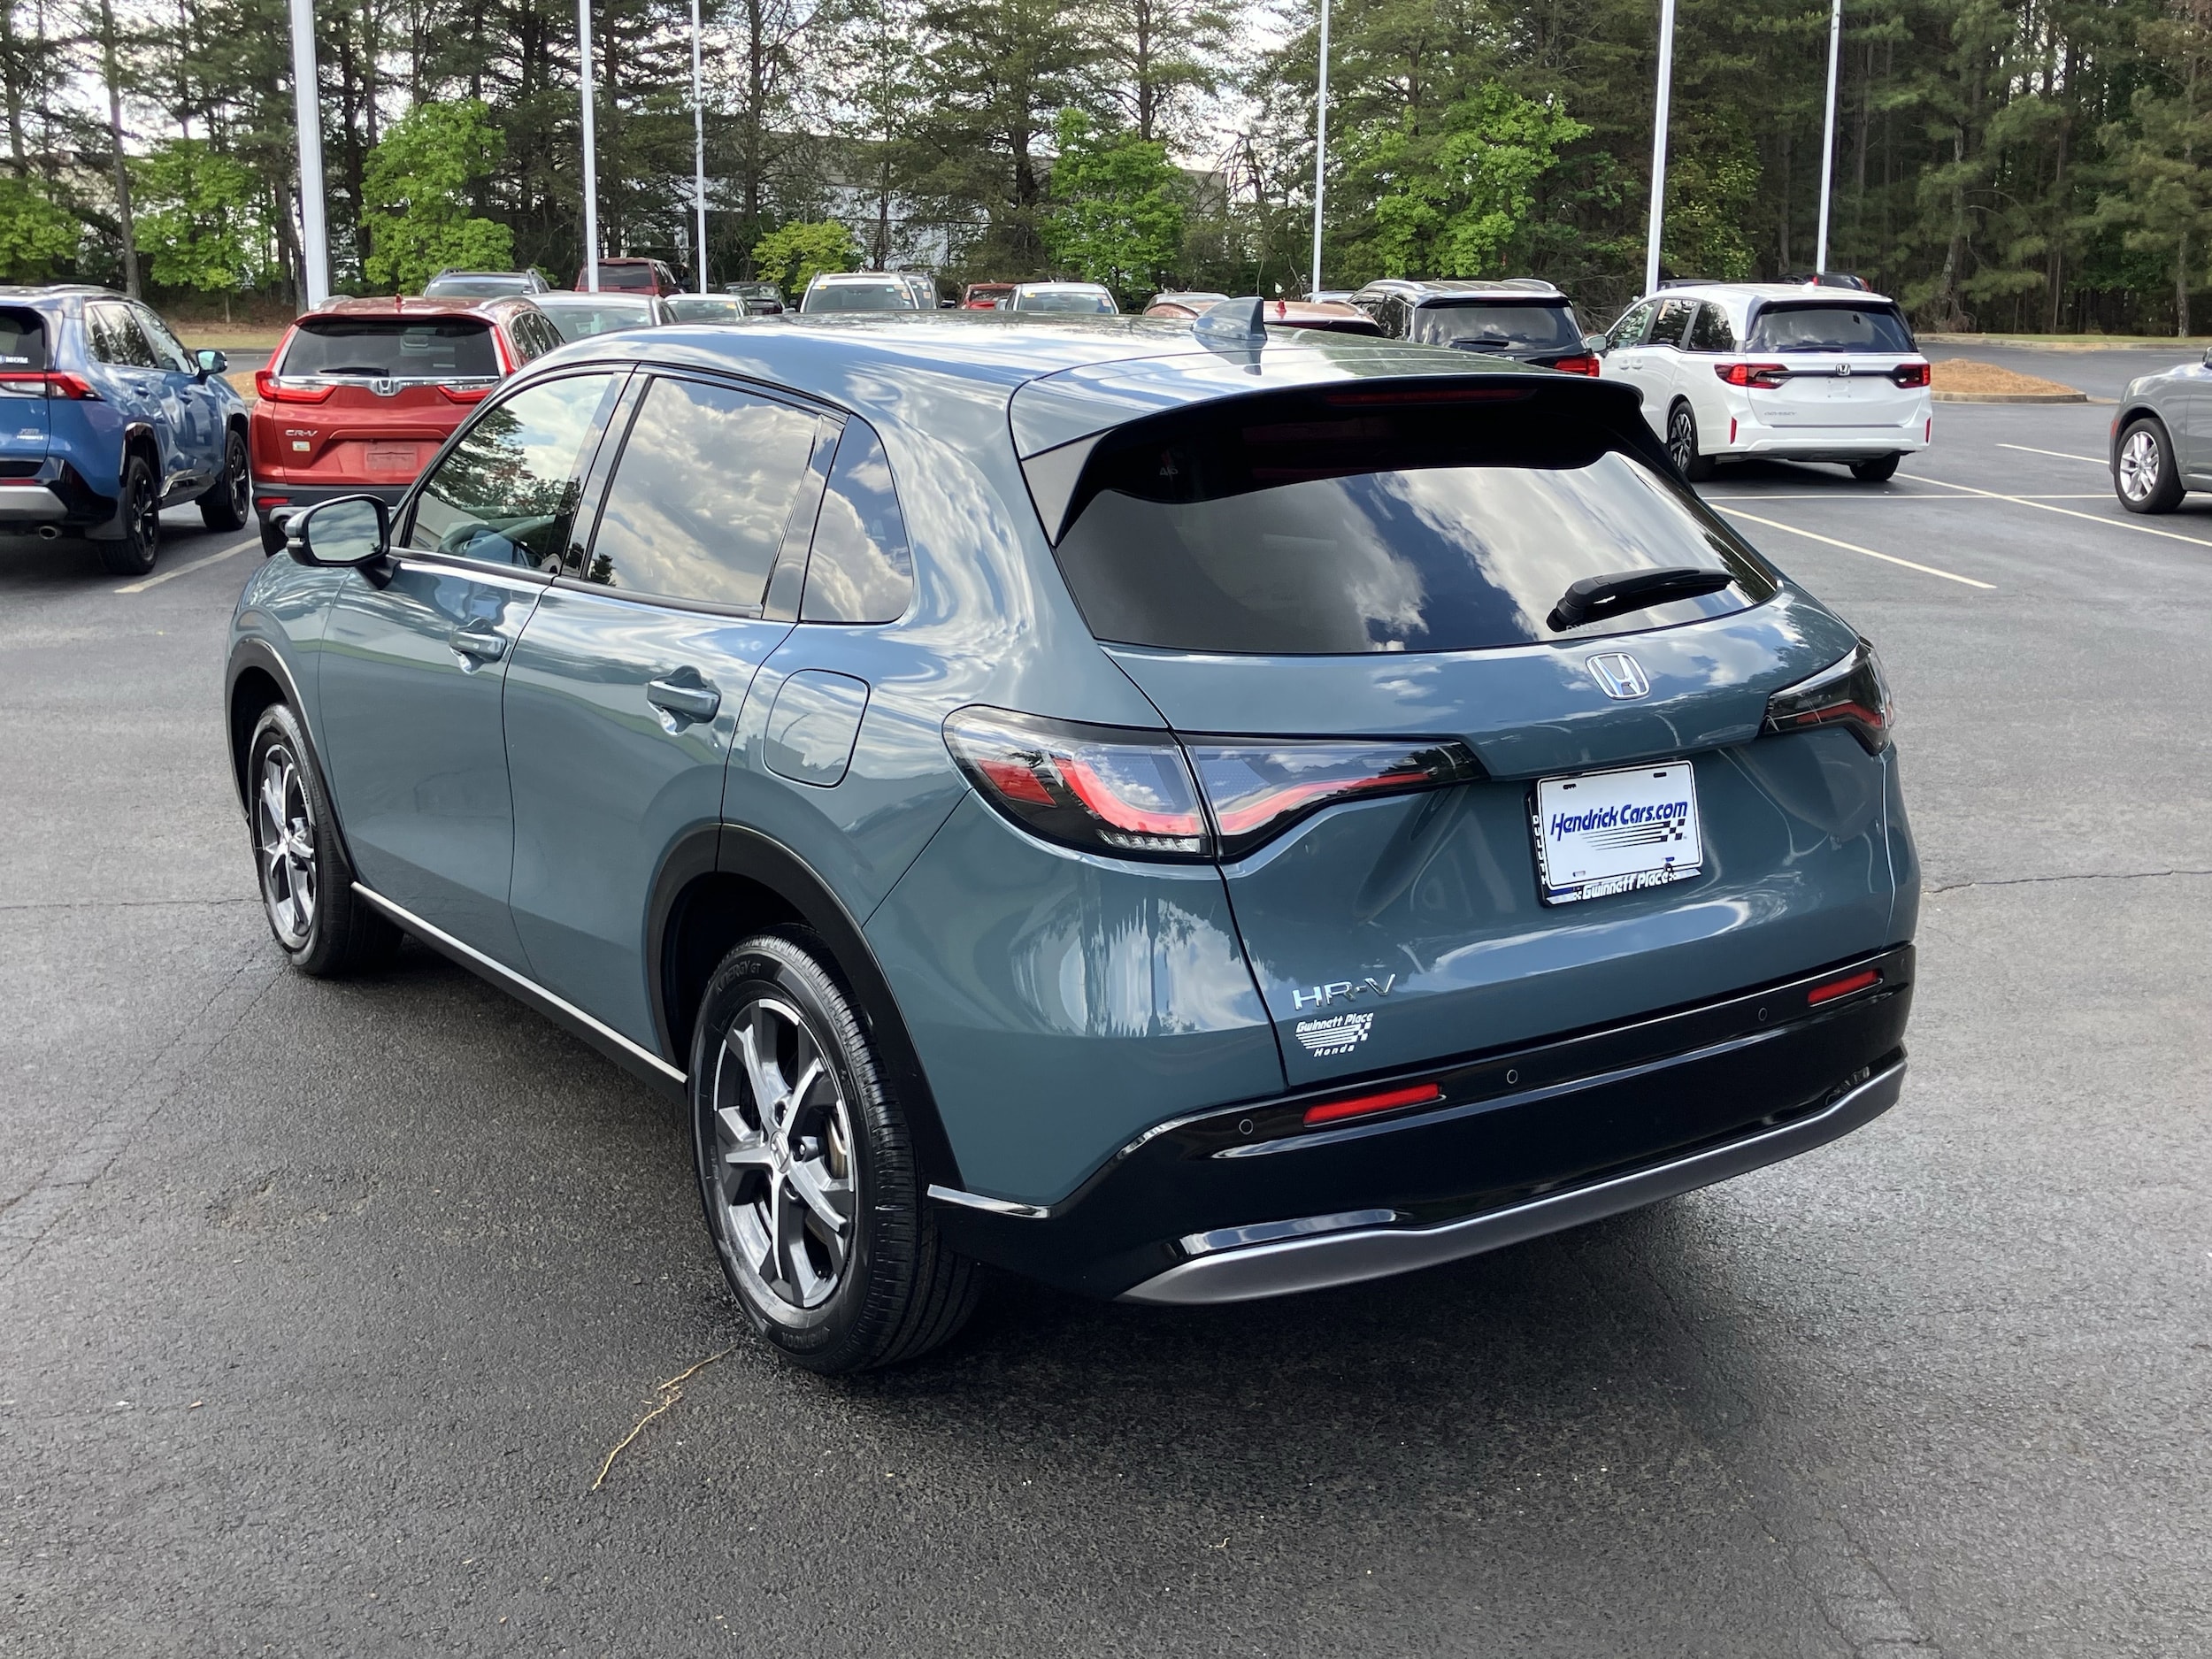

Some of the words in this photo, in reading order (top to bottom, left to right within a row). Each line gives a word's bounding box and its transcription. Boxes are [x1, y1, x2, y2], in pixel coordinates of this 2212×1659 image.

[1582, 873, 1634, 900] Gwinnett
[1636, 871, 1670, 889] Place
[1292, 973, 1396, 1010] HR-V
[1295, 1016, 1343, 1033] Gwinnett
[1344, 1012, 1373, 1026] Place
[1313, 1044, 1355, 1057] Honda
